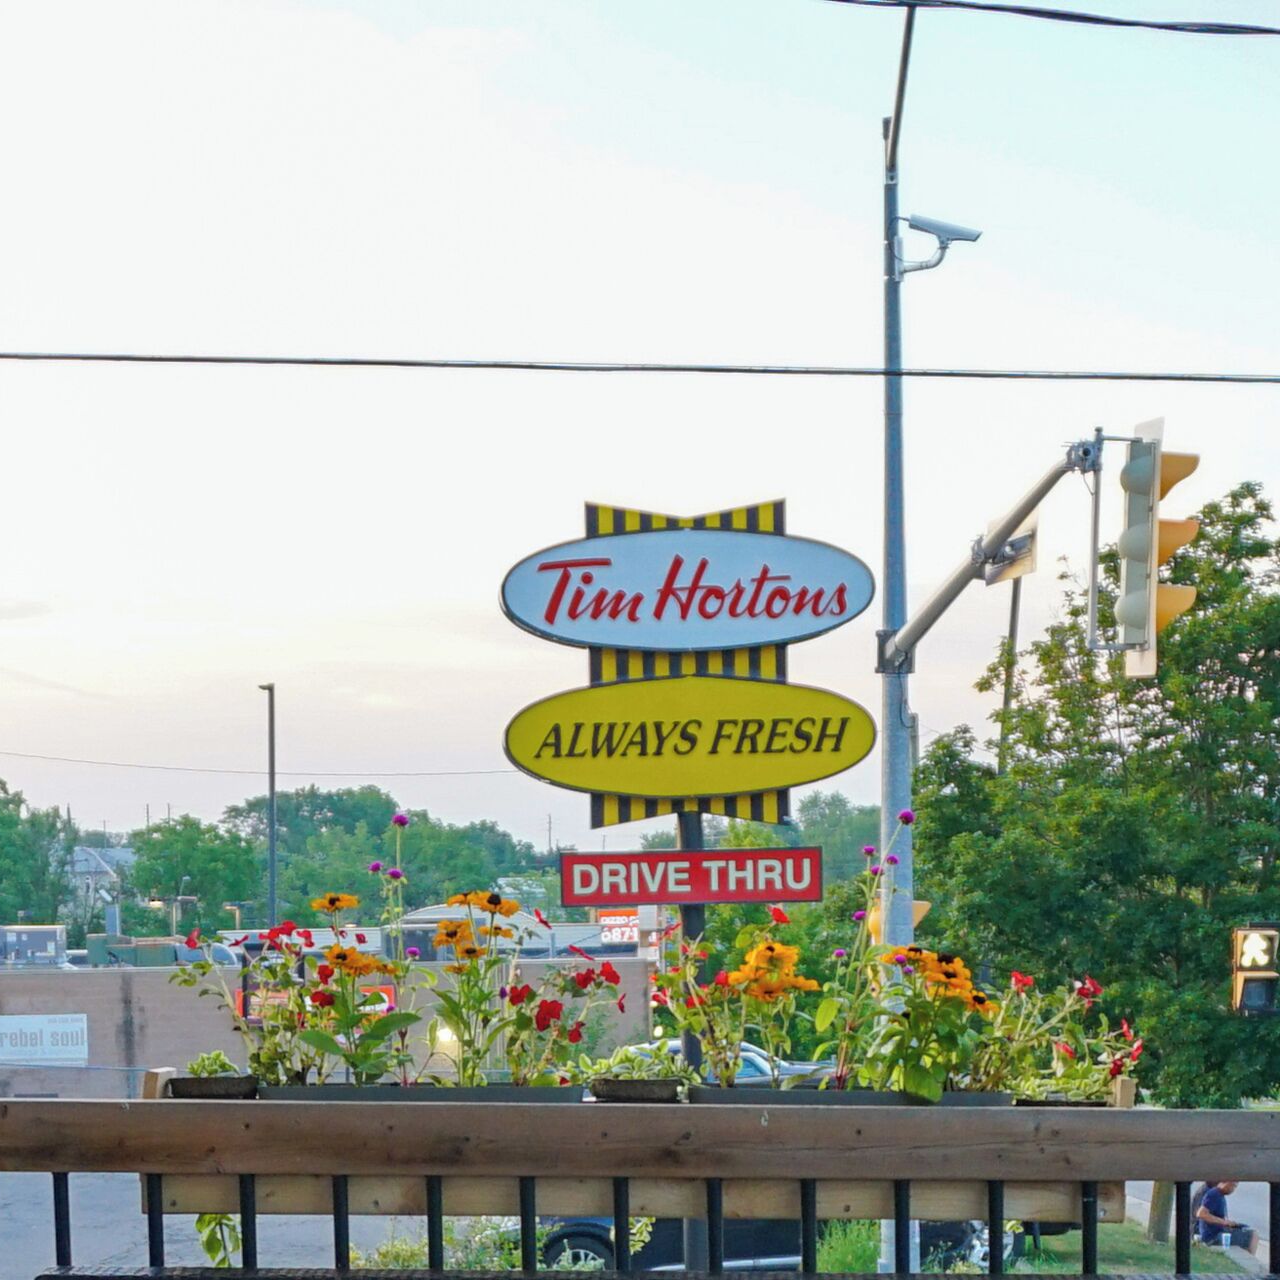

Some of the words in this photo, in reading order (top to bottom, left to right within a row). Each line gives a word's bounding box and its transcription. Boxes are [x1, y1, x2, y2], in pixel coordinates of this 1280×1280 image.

[537, 556, 645, 625] Tim
[652, 554, 848, 621] Hortons
[534, 720, 703, 759] ALWAYS
[708, 717, 852, 755] FRESH
[572, 861, 692, 895] DRIVE
[702, 857, 811, 892] THRU
[0, 1028, 44, 1048] rebel
[50, 1027, 85, 1047] soul
